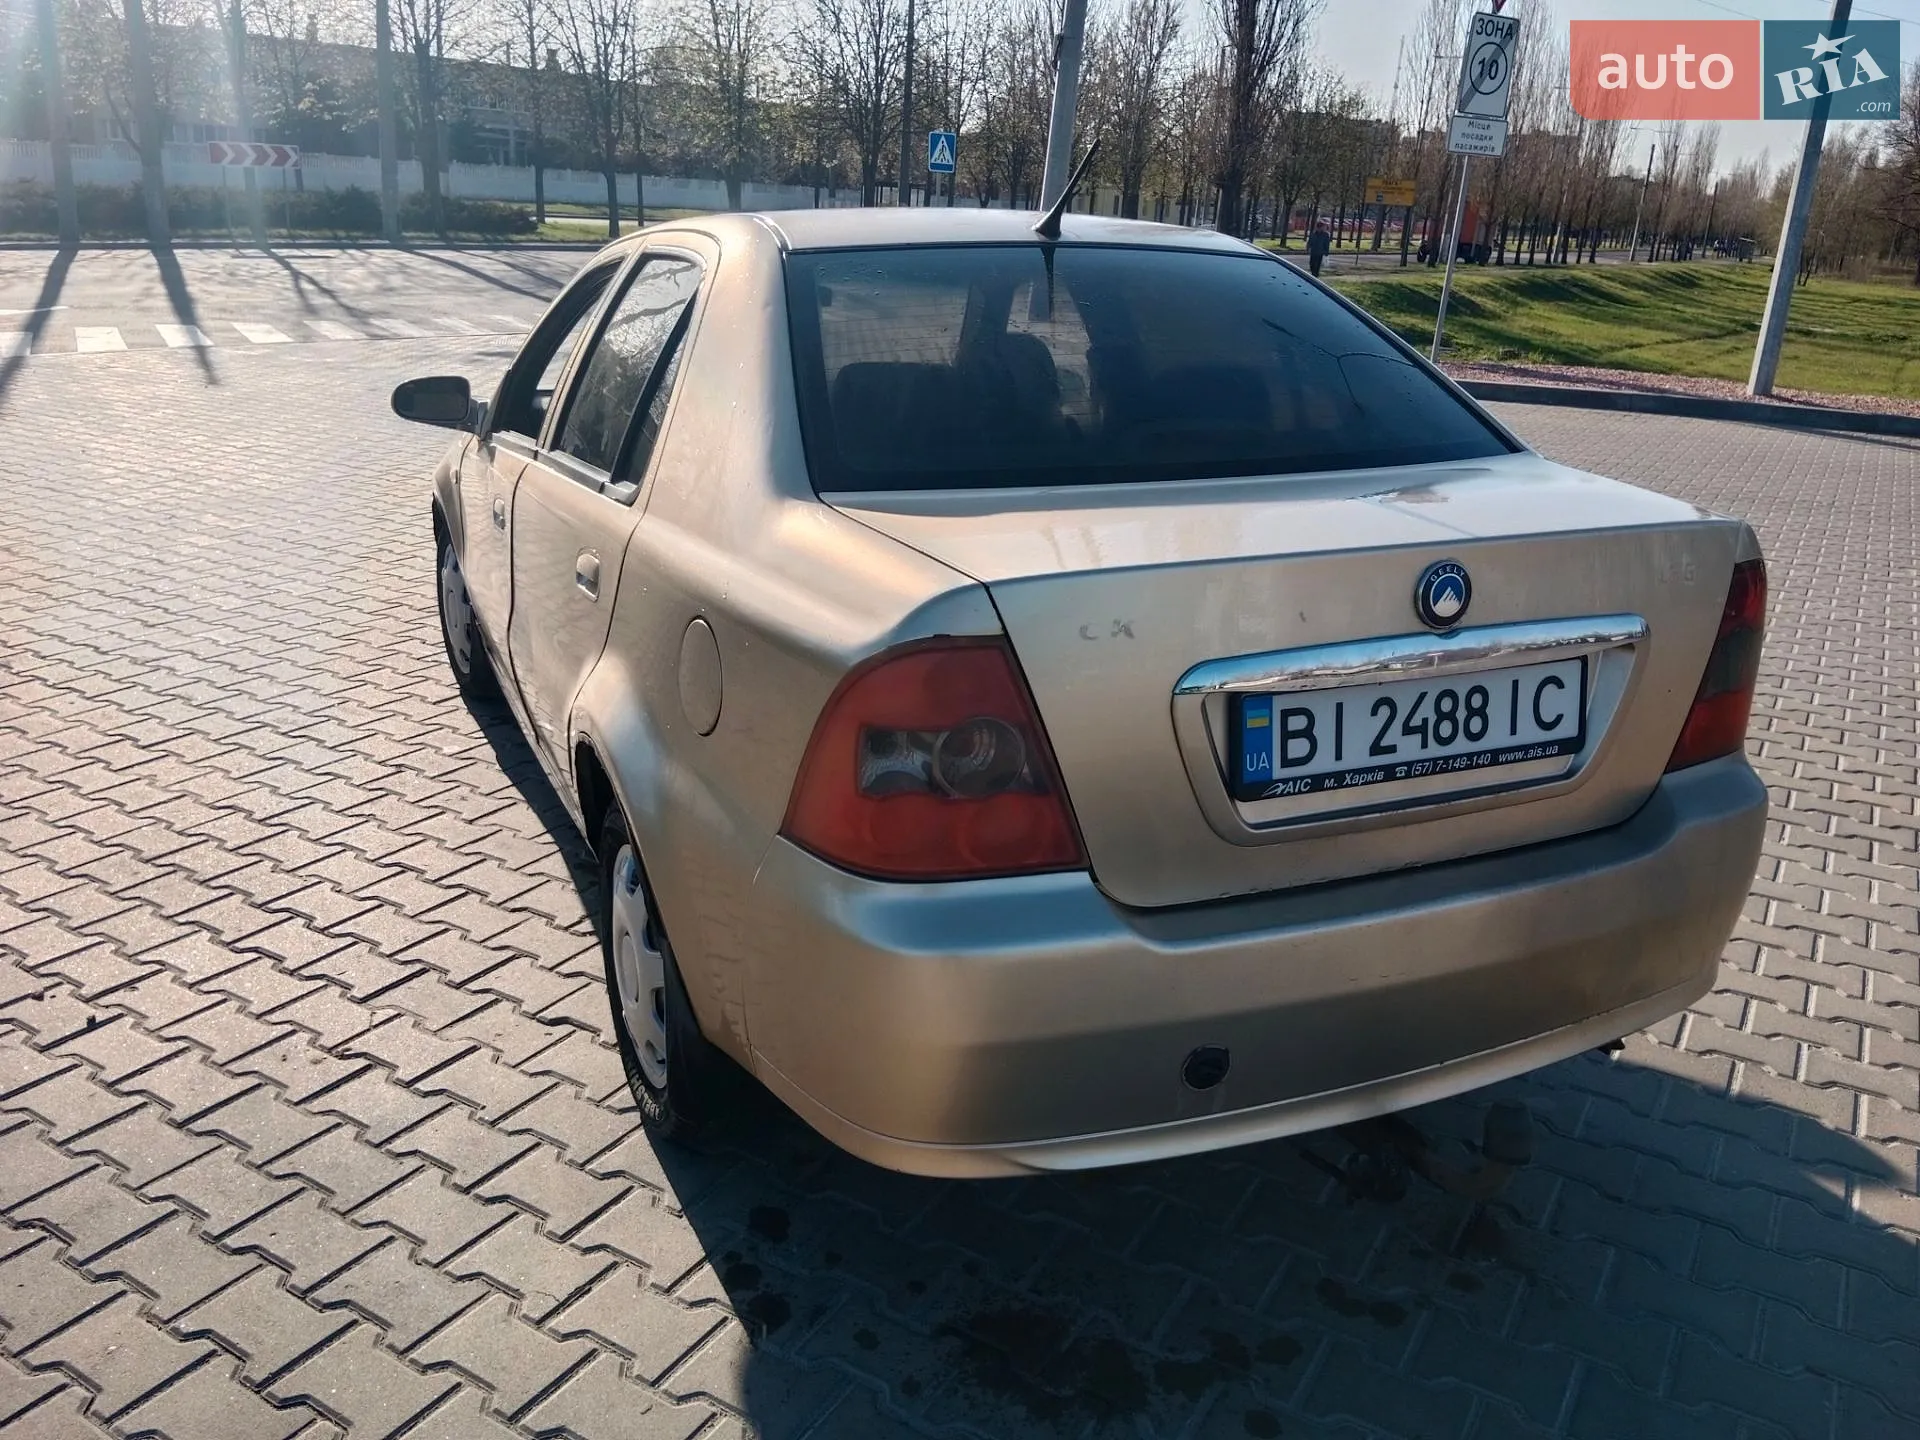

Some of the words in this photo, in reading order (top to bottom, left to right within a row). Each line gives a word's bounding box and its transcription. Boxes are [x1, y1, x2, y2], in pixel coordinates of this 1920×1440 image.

[1475, 19, 1514, 41] ЗОНА
[1478, 57, 1499, 81] 10
[1280, 702, 1344, 769] BI
[1369, 684, 1490, 757] 2488
[1509, 675, 1566, 736] IC
[1246, 751, 1270, 772] UA
[1343, 769, 1385, 787] Харків
[1411, 761, 1433, 776] (57)
[1436, 753, 1491, 772] 7-149-140
[1498, 745, 1559, 763] www.ais.ua
